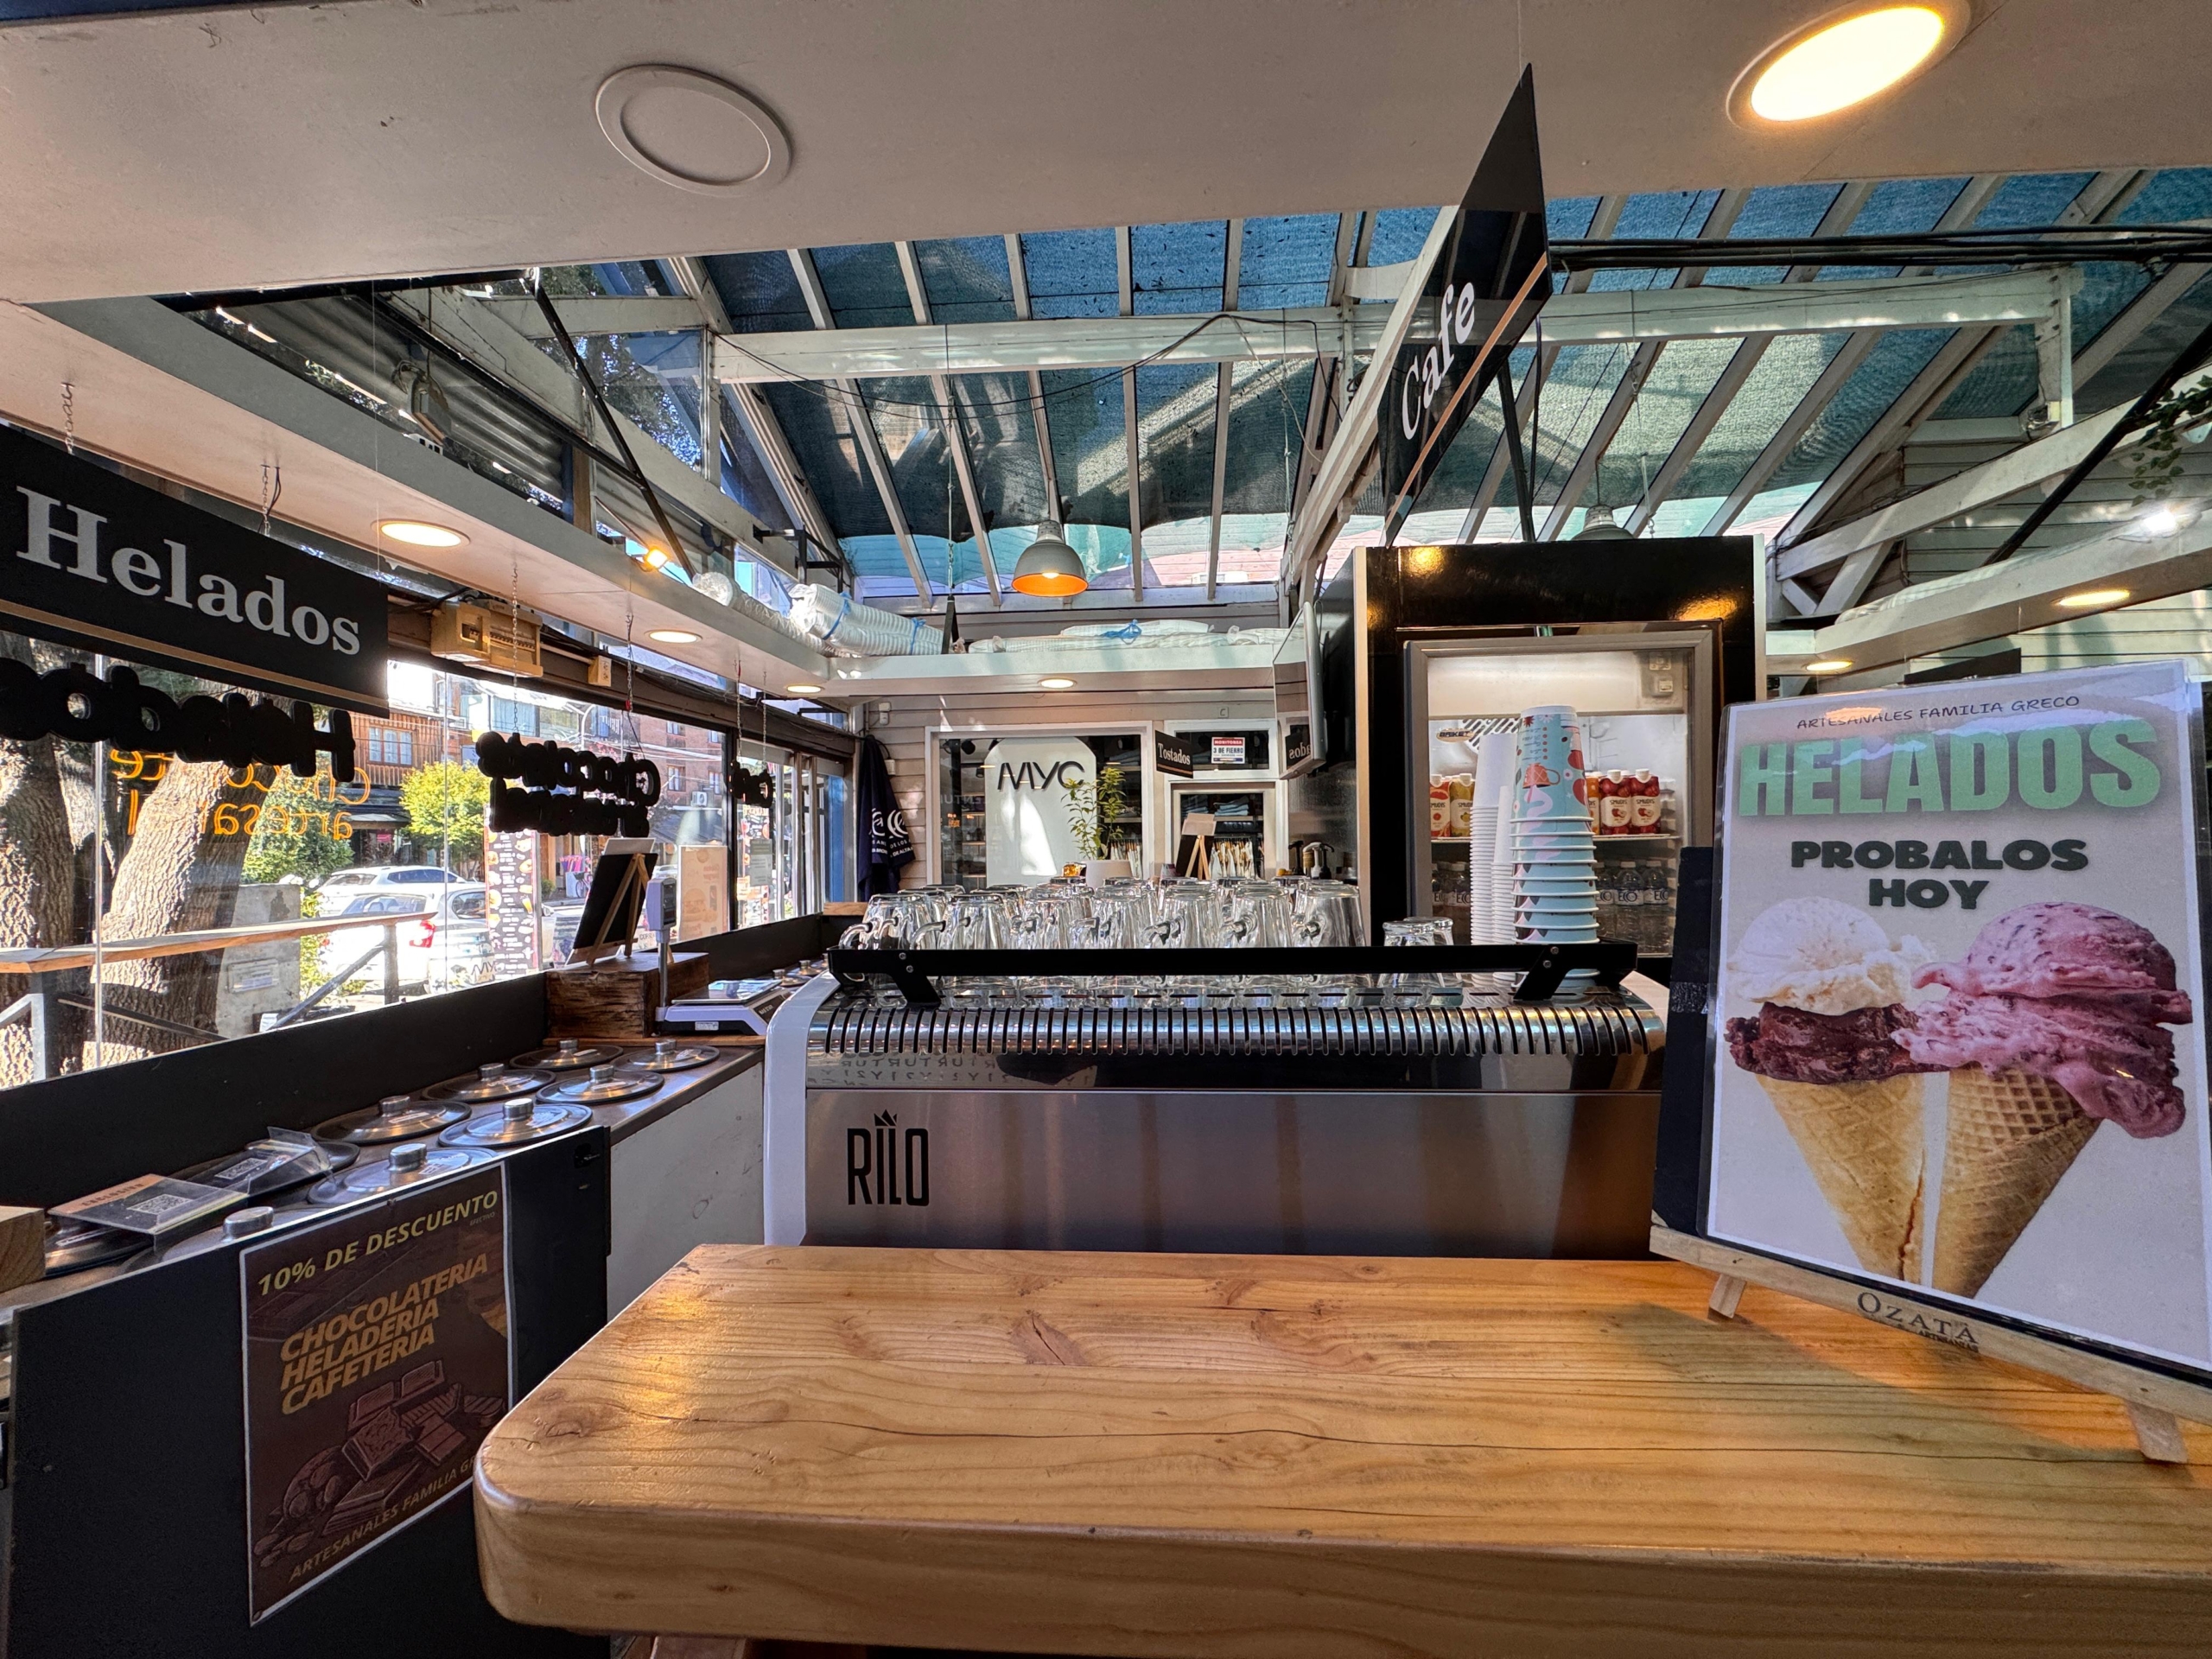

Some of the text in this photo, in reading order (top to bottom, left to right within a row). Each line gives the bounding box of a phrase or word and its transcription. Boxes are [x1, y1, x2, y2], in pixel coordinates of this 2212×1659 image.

[1402, 282, 1475, 440] Cafe
[16, 486, 360, 656] Helados
[1157, 742, 1191, 766] Tostados
[1797, 696, 2080, 729] ARTESANALES FAMILIA GRECO
[997, 760, 1085, 791] MYC
[1738, 717, 2161, 817] HELADOS
[1791, 839, 2088, 871] PROBALOS
[1869, 879, 1989, 909] HOY
[847, 1127, 930, 1207] RILO
[258, 1190, 499, 1296] 10% DE DESCUENTO
[469, 1211, 495, 1227] EFECTIVO
[280, 1253, 489, 1363] CHOCOLATERIA
[280, 1297, 439, 1393] HELADERIA
[1857, 1292, 1980, 1344] OZATA
[282, 1323, 435, 1415] CAFETERIA
[288, 1506, 398, 1584] ARTESANALES
[402, 1469, 457, 1511] FAMILIA
